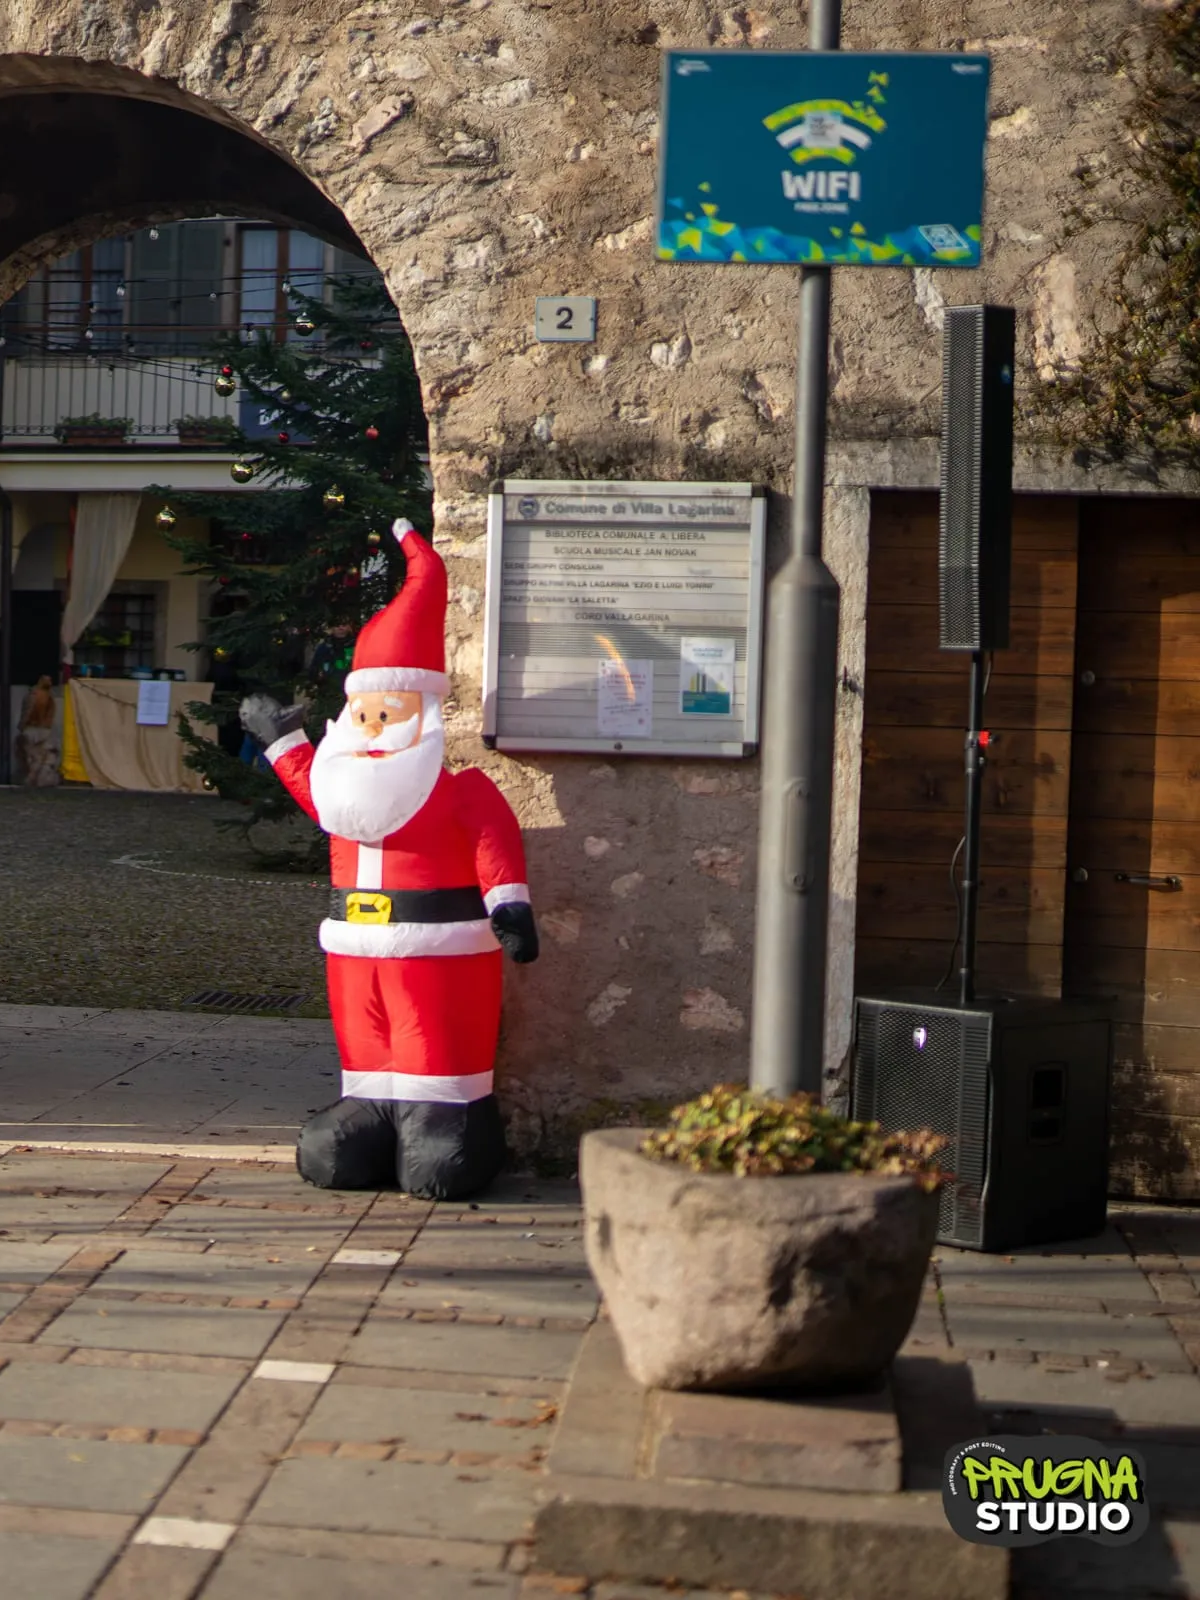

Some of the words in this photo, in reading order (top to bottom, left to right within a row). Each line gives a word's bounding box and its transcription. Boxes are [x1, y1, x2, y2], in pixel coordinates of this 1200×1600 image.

[781, 170, 861, 201] WIFI
[556, 306, 573, 329] 2
[545, 501, 607, 514] Comune
[612, 502, 626, 514] di
[631, 502, 663, 514] Villa
[668, 503, 736, 518] Lagarina
[545, 530, 600, 538] BIBLIOTECA
[602, 531, 655, 540] COMUNALE
[672, 532, 706, 541] LIBERA
[553, 546, 591, 555] SCUOLA
[593, 547, 640, 556] MUSICALE
[643, 548, 662, 557] JAN
[664, 549, 697, 557] NOVAK
[574, 612, 602, 621] CORO
[604, 612, 670, 621] VALLAGARINA
